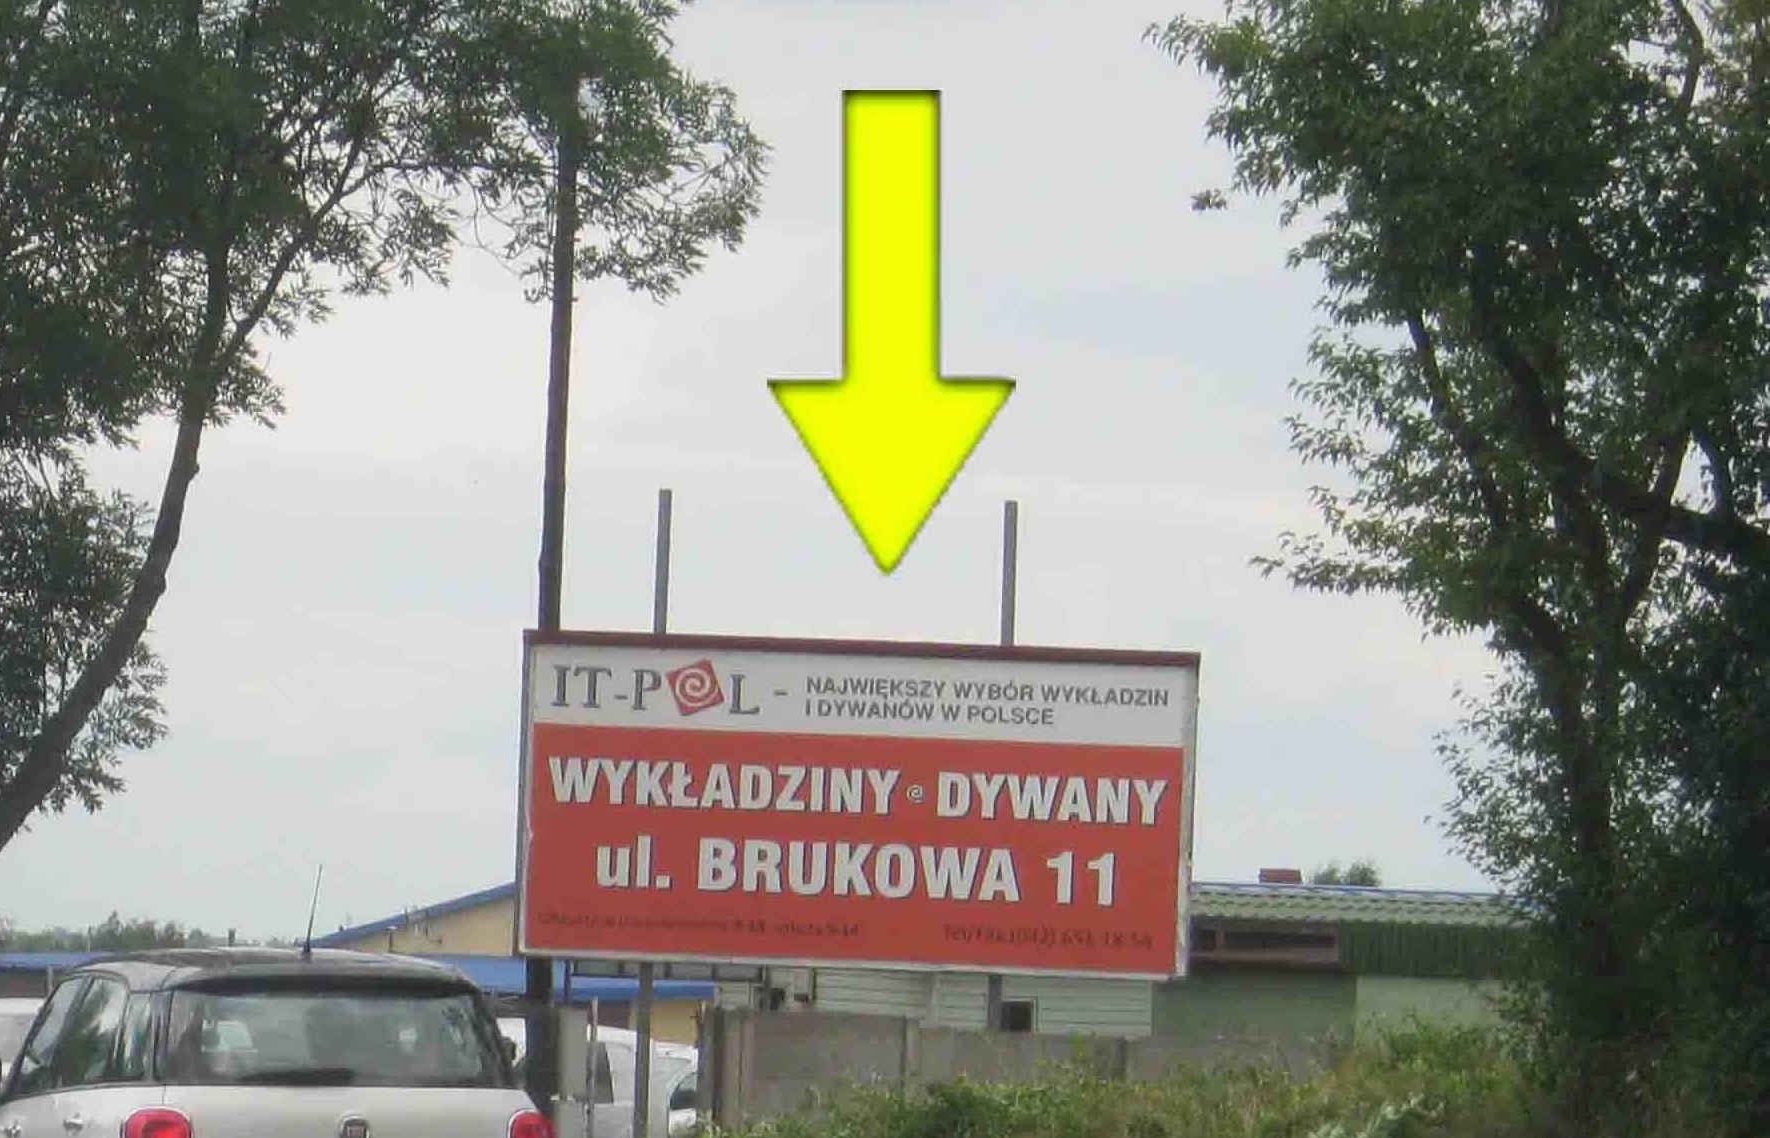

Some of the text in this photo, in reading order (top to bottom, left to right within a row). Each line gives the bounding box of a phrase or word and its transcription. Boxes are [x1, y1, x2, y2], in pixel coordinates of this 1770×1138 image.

[805, 674, 1170, 708] NAJWIĘKSZY WYBÓR WYKŁADZIN
[816, 699, 935, 722] DYWANÓW
[941, 704, 962, 723] W
[966, 704, 1056, 726] POLSCE
[548, 755, 1169, 827] WYKŁADZINY DYWANY
[595, 834, 1118, 908] ul. BRUKOWA 11
